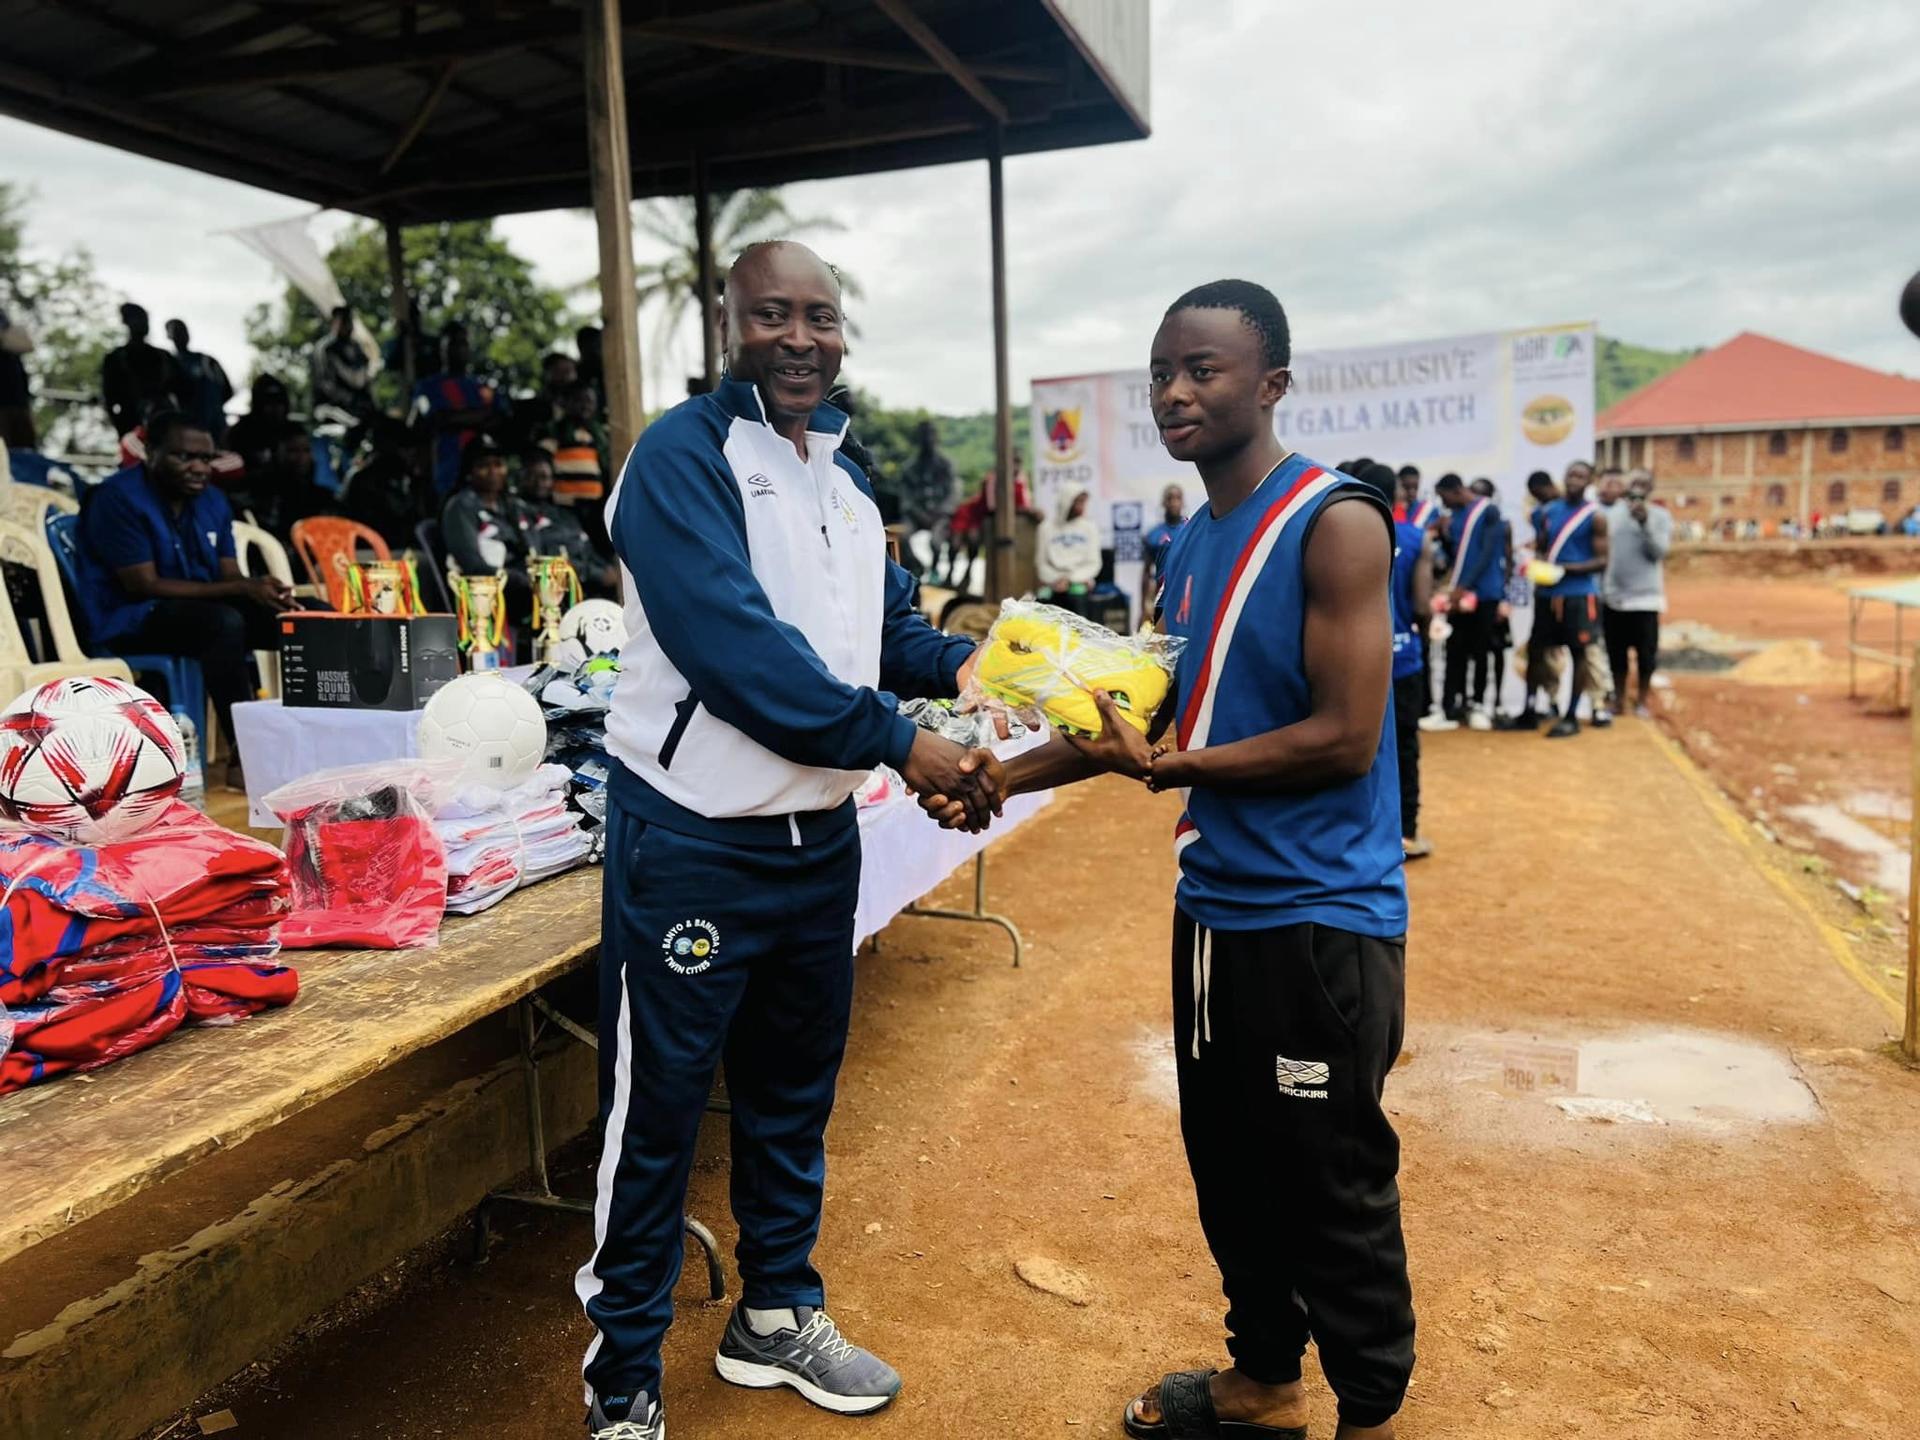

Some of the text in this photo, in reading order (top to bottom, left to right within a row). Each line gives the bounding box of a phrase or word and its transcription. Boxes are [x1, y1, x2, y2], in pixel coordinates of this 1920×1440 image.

[1339, 350, 1476, 392] INCLUSIVE
[1296, 402, 1371, 435] GALA
[1381, 394, 1476, 430] MATCH
[316, 681, 351, 694] SOUND
[662, 923, 684, 949] BANYO
[686, 920, 692, 928] &
[664, 955, 711, 975] TWIN CITIES
